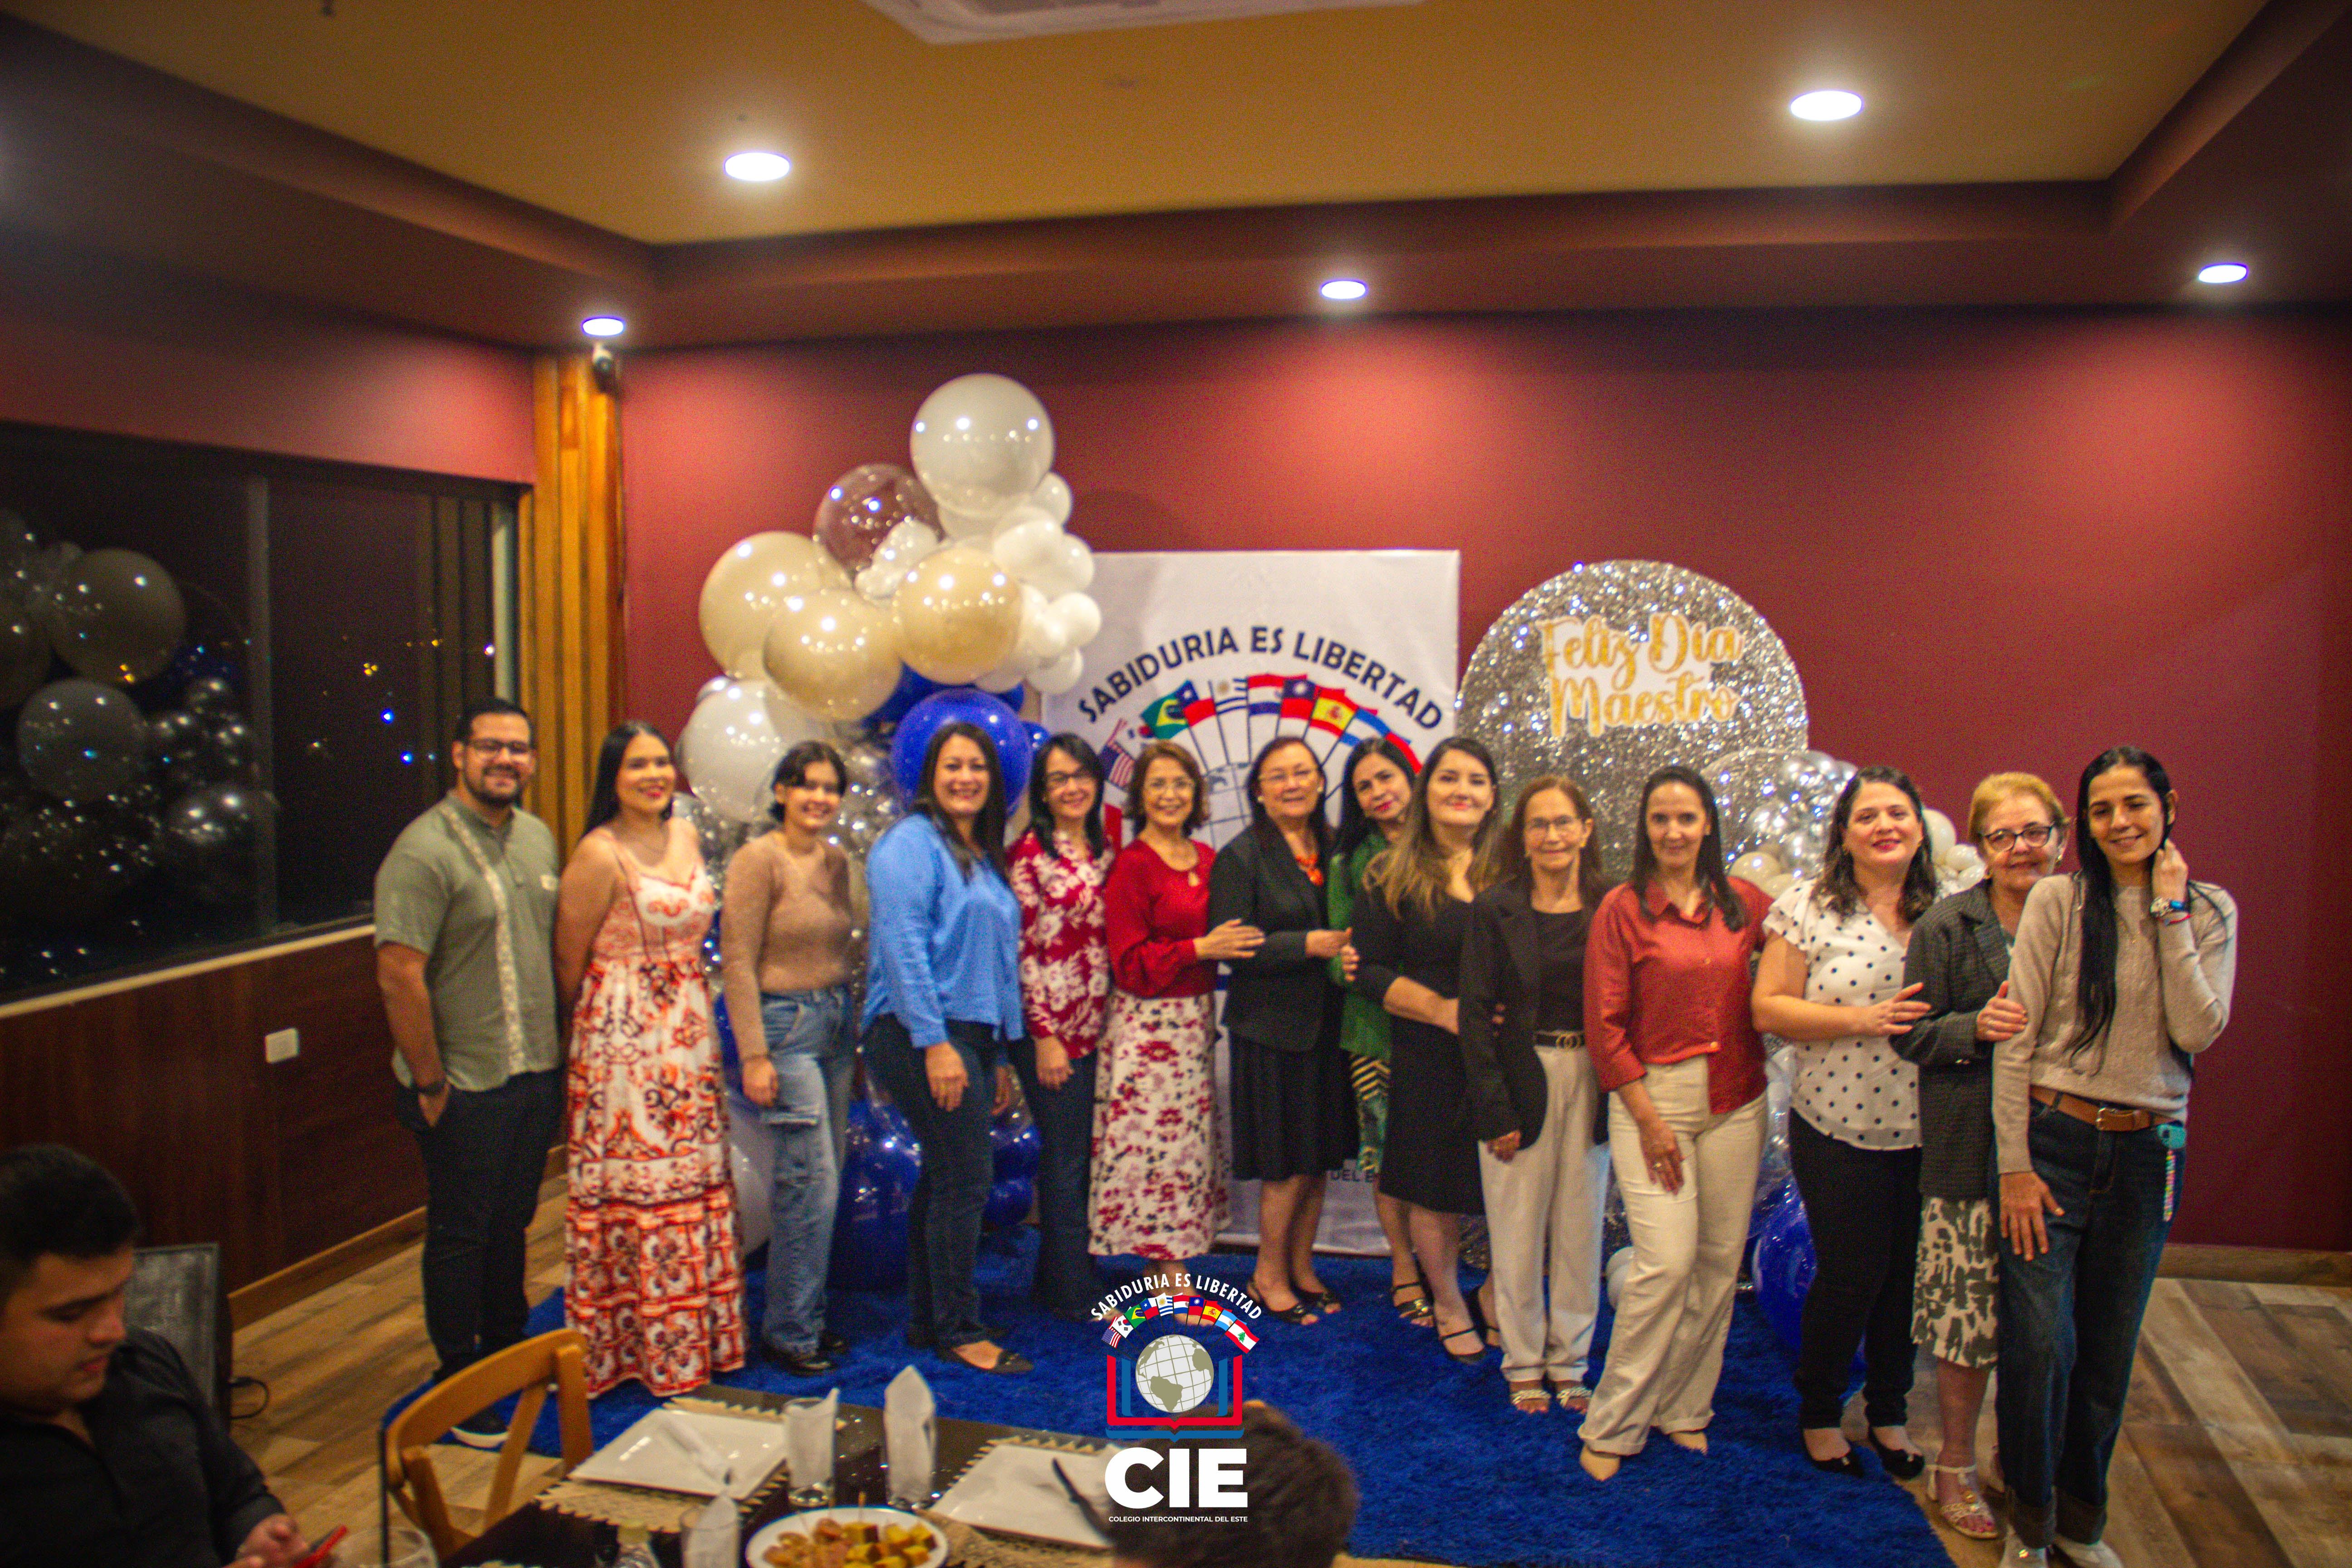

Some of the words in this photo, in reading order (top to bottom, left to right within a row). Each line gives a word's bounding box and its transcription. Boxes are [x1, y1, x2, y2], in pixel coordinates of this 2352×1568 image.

[1079, 627, 1240, 722] SABIDURIA
[1250, 626, 1284, 654] ES
[1293, 632, 1443, 730] LIBERTAD
[1537, 616, 1639, 690] Feliz
[1549, 671, 1737, 737] Maestro
